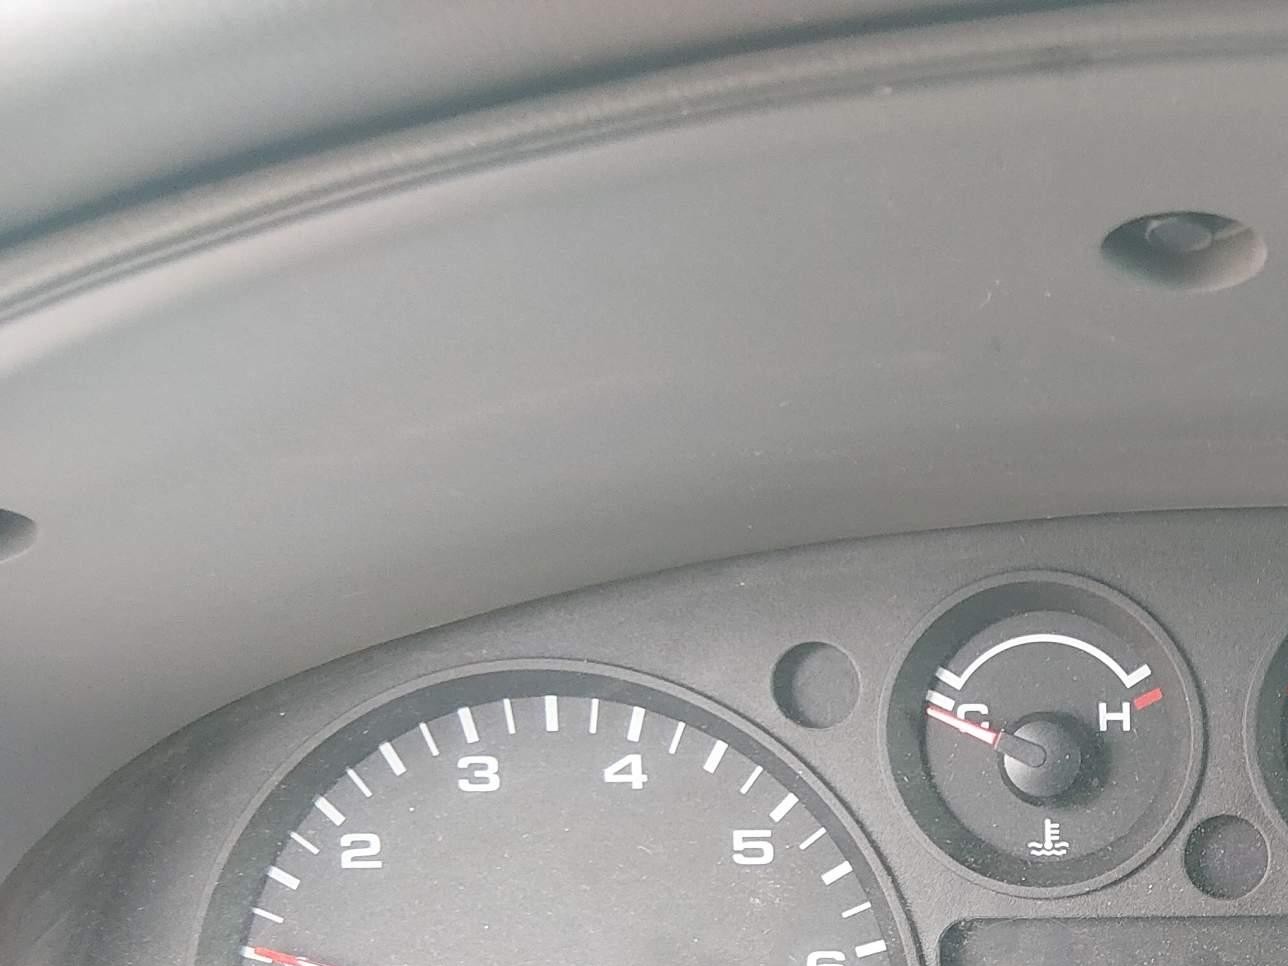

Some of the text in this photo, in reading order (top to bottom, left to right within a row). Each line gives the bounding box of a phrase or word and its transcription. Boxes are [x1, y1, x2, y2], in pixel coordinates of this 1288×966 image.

[1099, 702, 1130, 731] H
[458, 756, 499, 791] 3
[604, 755, 647, 789] 4
[341, 834, 382, 868] 2
[733, 830, 773, 864] 5
